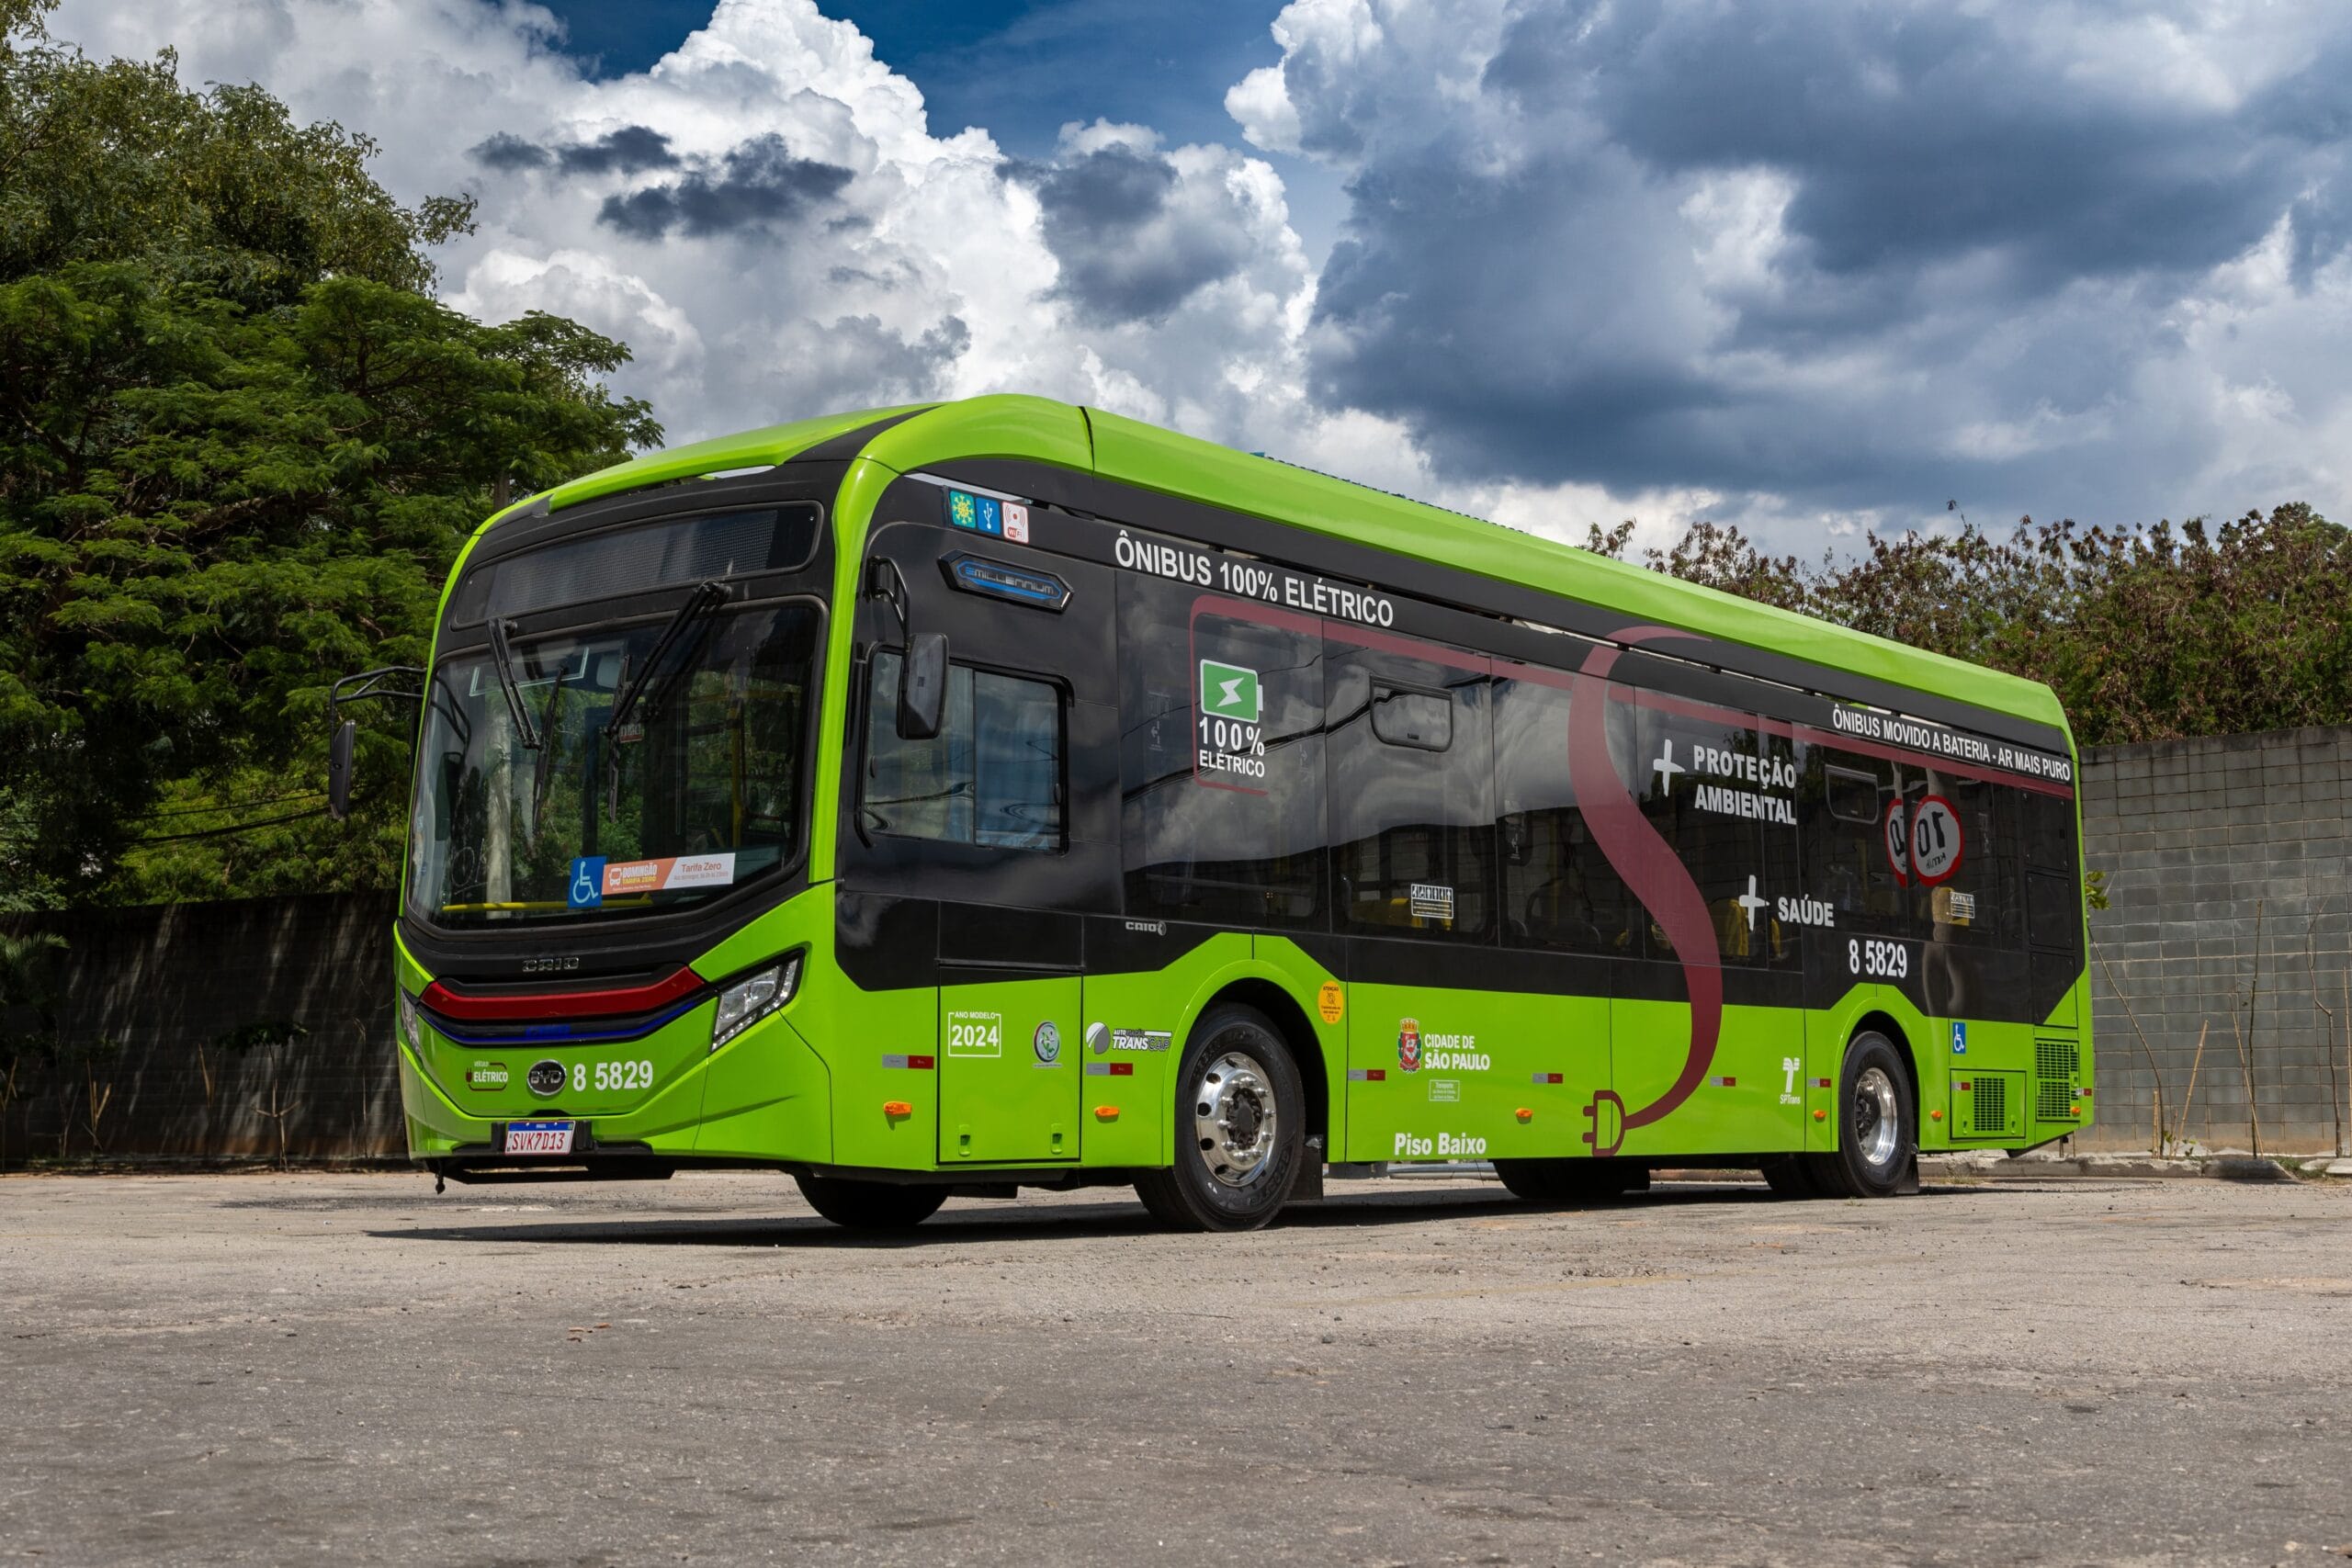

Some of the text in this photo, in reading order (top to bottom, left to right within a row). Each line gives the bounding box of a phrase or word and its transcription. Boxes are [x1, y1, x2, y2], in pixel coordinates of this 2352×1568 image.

[1114, 529, 1394, 626] ÔNIBUS 100% ELÉTRICO
[1199, 716, 1265, 757] 100%
[1833, 704, 1880, 738] ÔNIBUS
[1883, 719, 1930, 749] MOVIDO
[1932, 735, 1941, 751] A
[1943, 734, 1990, 763] BATERIA
[1998, 748, 2013, 768] AR
[2015, 752, 2041, 774] MAIS
[2043, 761, 2071, 781] PURO
[1199, 749, 1265, 778] ELÉTRICO
[1693, 745, 1797, 790] PROTEÇÃO
[1694, 784, 1797, 826] AMBIENTAL
[682, 862, 722, 873] Tarifa Zero
[1778, 895, 1835, 927] SAÚDE
[1849, 939, 1907, 978] 8 5829
[969, 1011, 996, 1020] MODELO
[951, 1024, 999, 1047] 2024
[1425, 1033, 1475, 1049] CIDADE DE
[1425, 1051, 1490, 1070] SÃO PAULO
[474, 1069, 508, 1083] ELÉTRICO
[530, 1070, 562, 1085] BYD
[573, 1060, 653, 1091] 8 5829
[512, 1132, 565, 1151] SVK7D13
[1395, 1132, 1487, 1156] Piso Baixo
